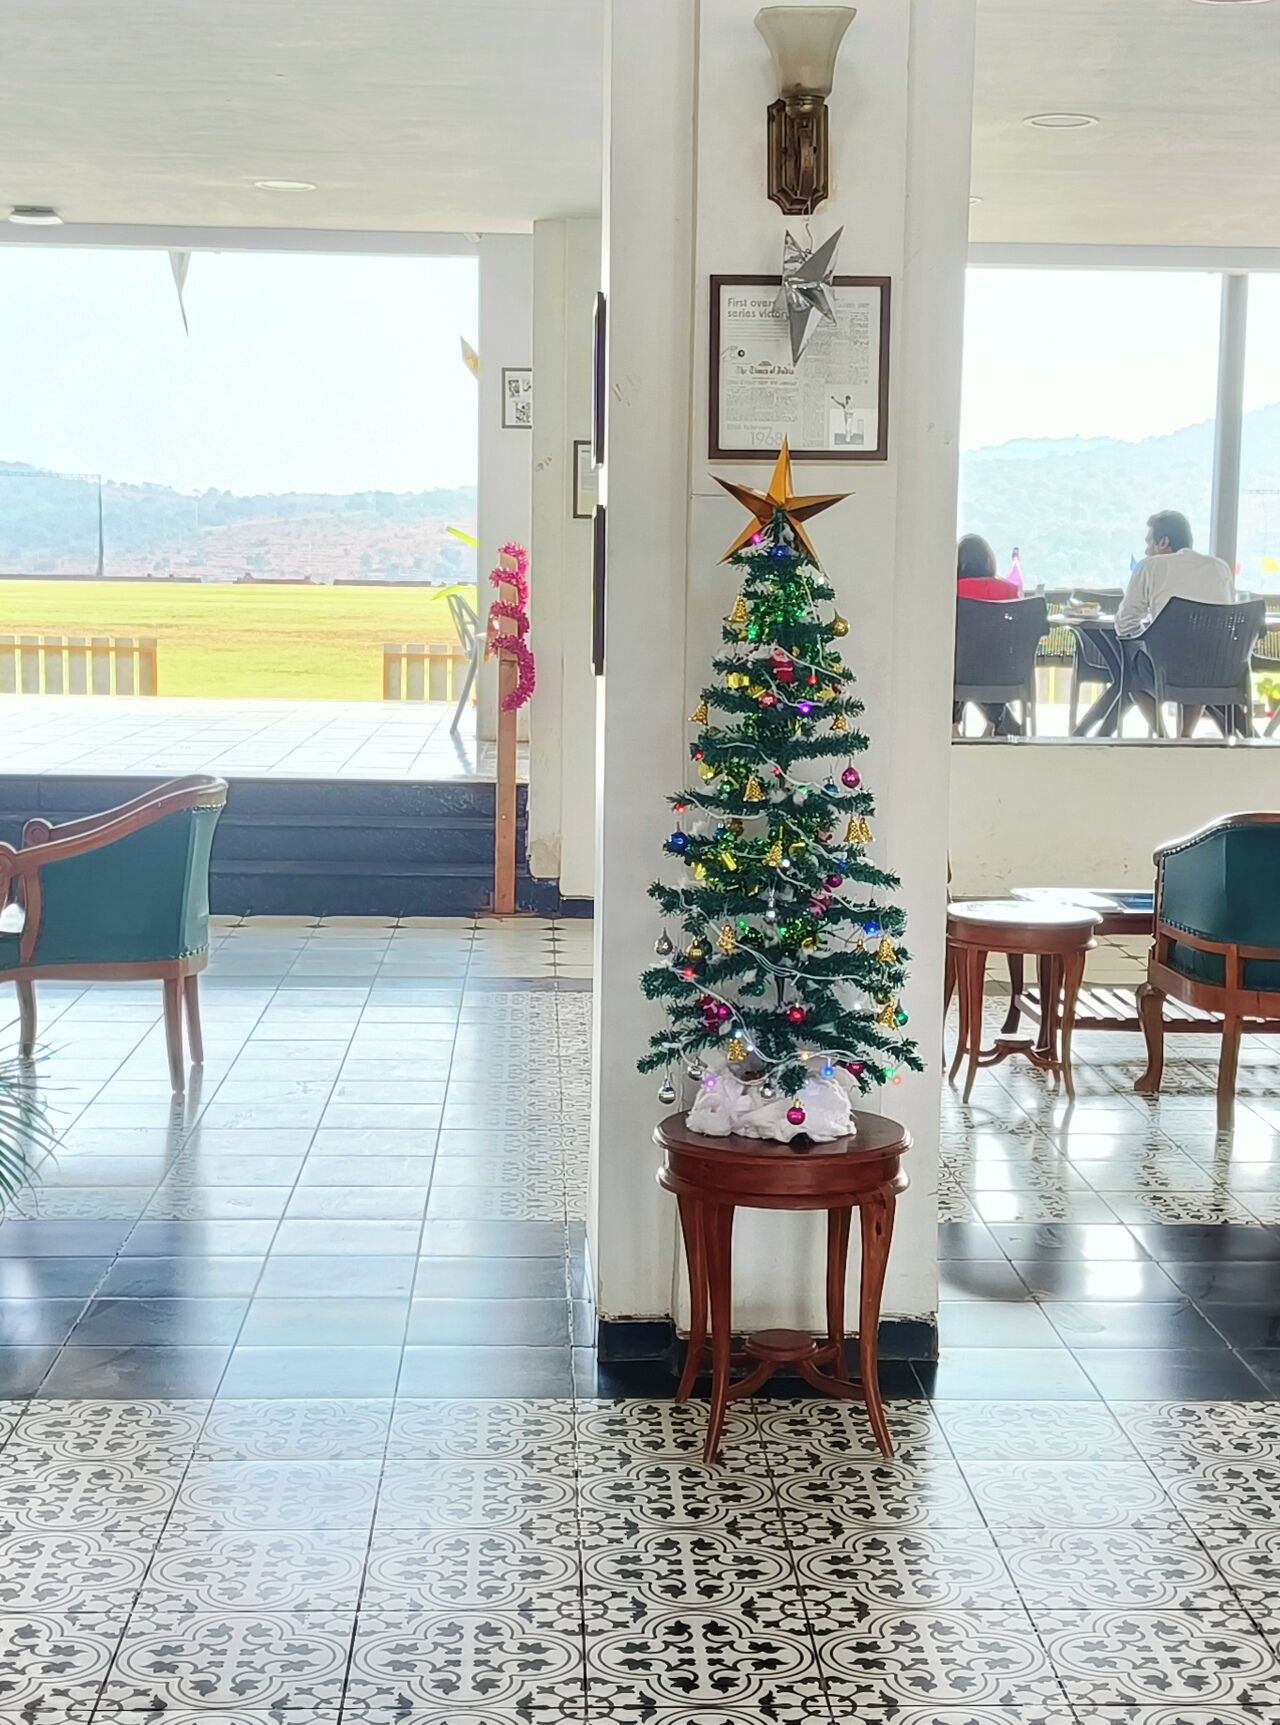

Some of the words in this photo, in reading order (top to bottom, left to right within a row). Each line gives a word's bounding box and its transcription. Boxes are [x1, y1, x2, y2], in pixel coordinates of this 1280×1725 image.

[727, 298, 747, 307] First
[727, 309, 756, 318] series
[759, 309, 791, 320] victory
[749, 366, 768, 375] Times
[777, 366, 794, 375] India
